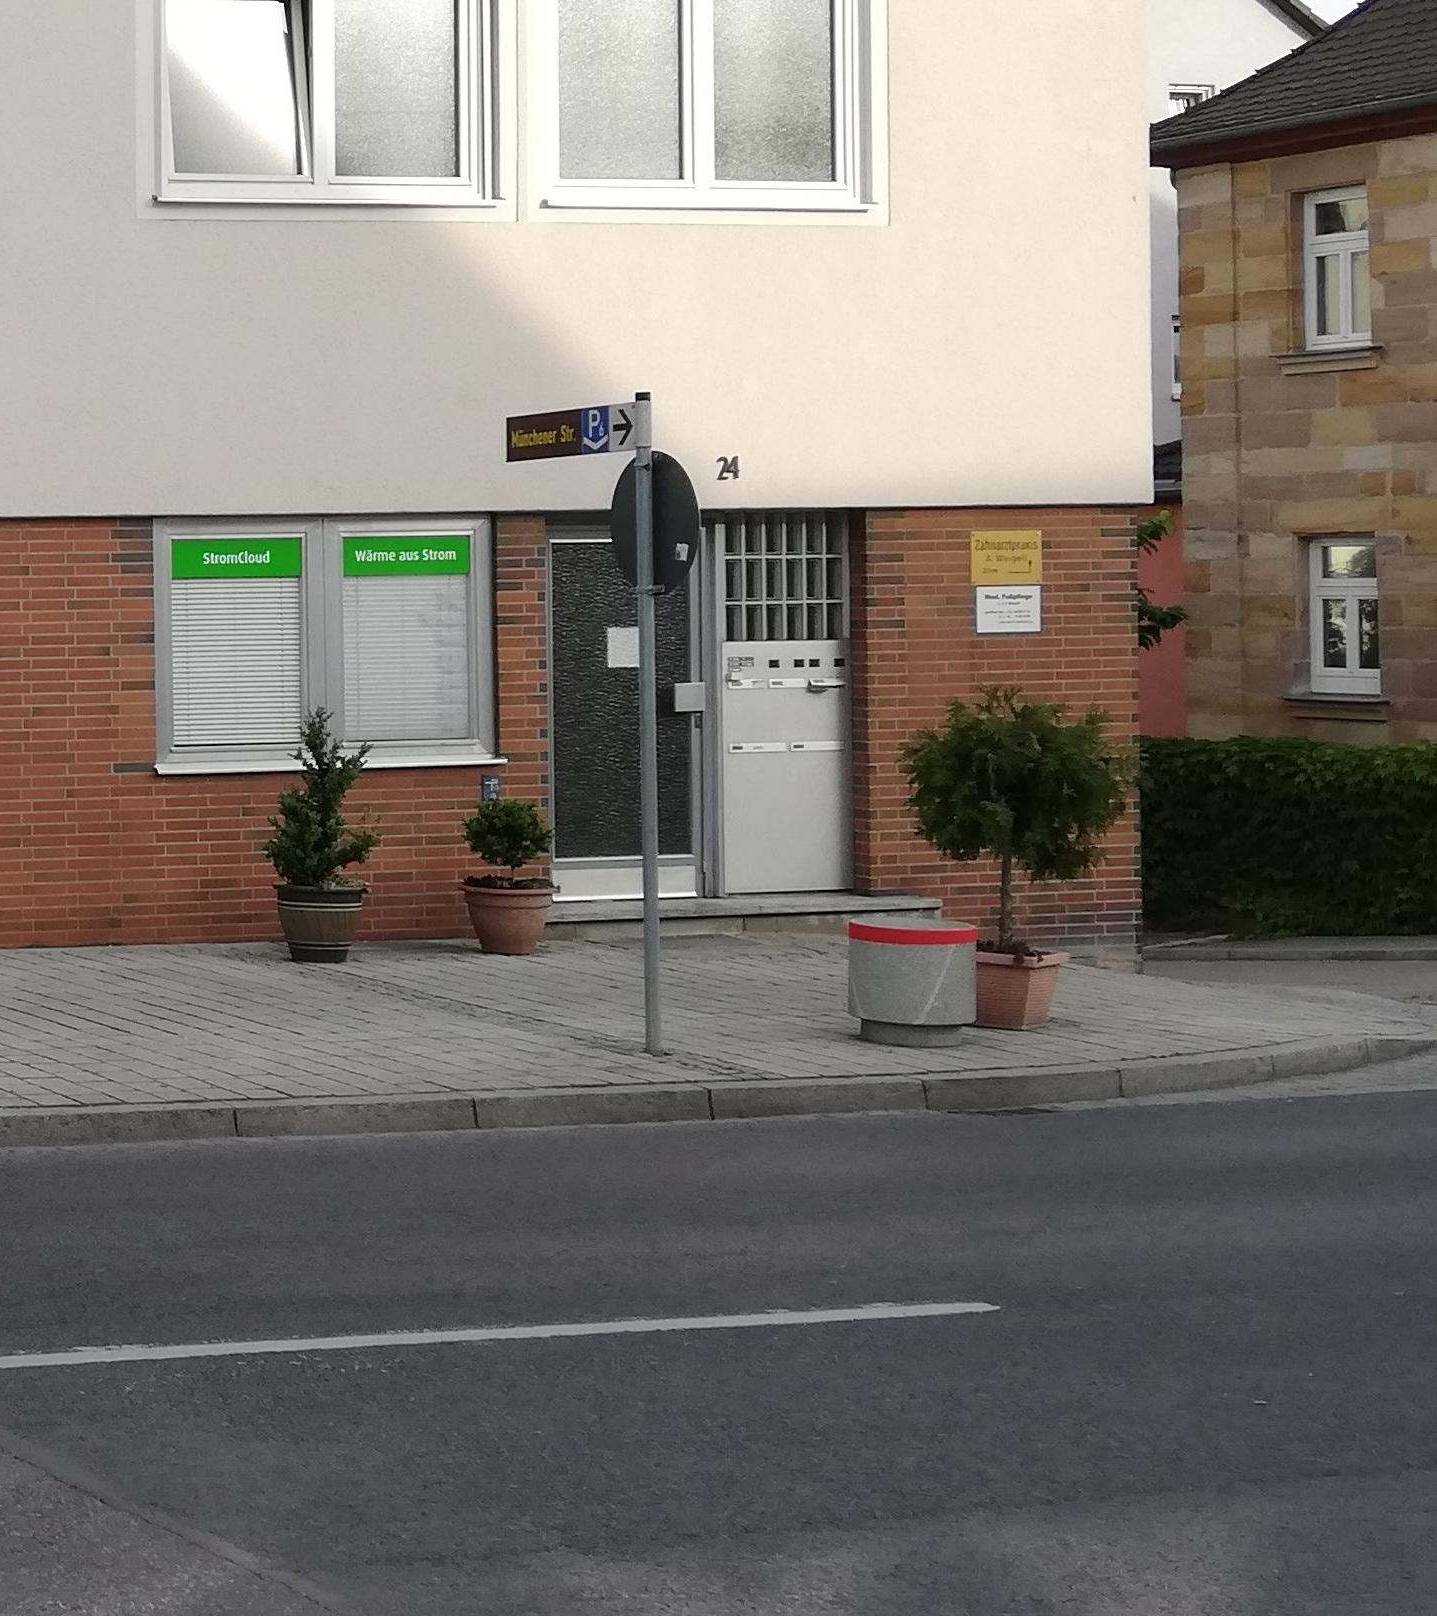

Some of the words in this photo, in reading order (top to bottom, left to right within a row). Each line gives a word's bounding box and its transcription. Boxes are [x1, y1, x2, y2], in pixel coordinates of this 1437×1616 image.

[511, 426, 556, 449] Münchener
[560, 424, 576, 443] Str.
[716, 456, 740, 480] 24
[202, 549, 270, 565] StromCloud
[355, 549, 396, 563] Wärme
[399, 550, 419, 562] aus
[422, 548, 457, 561] Strom
